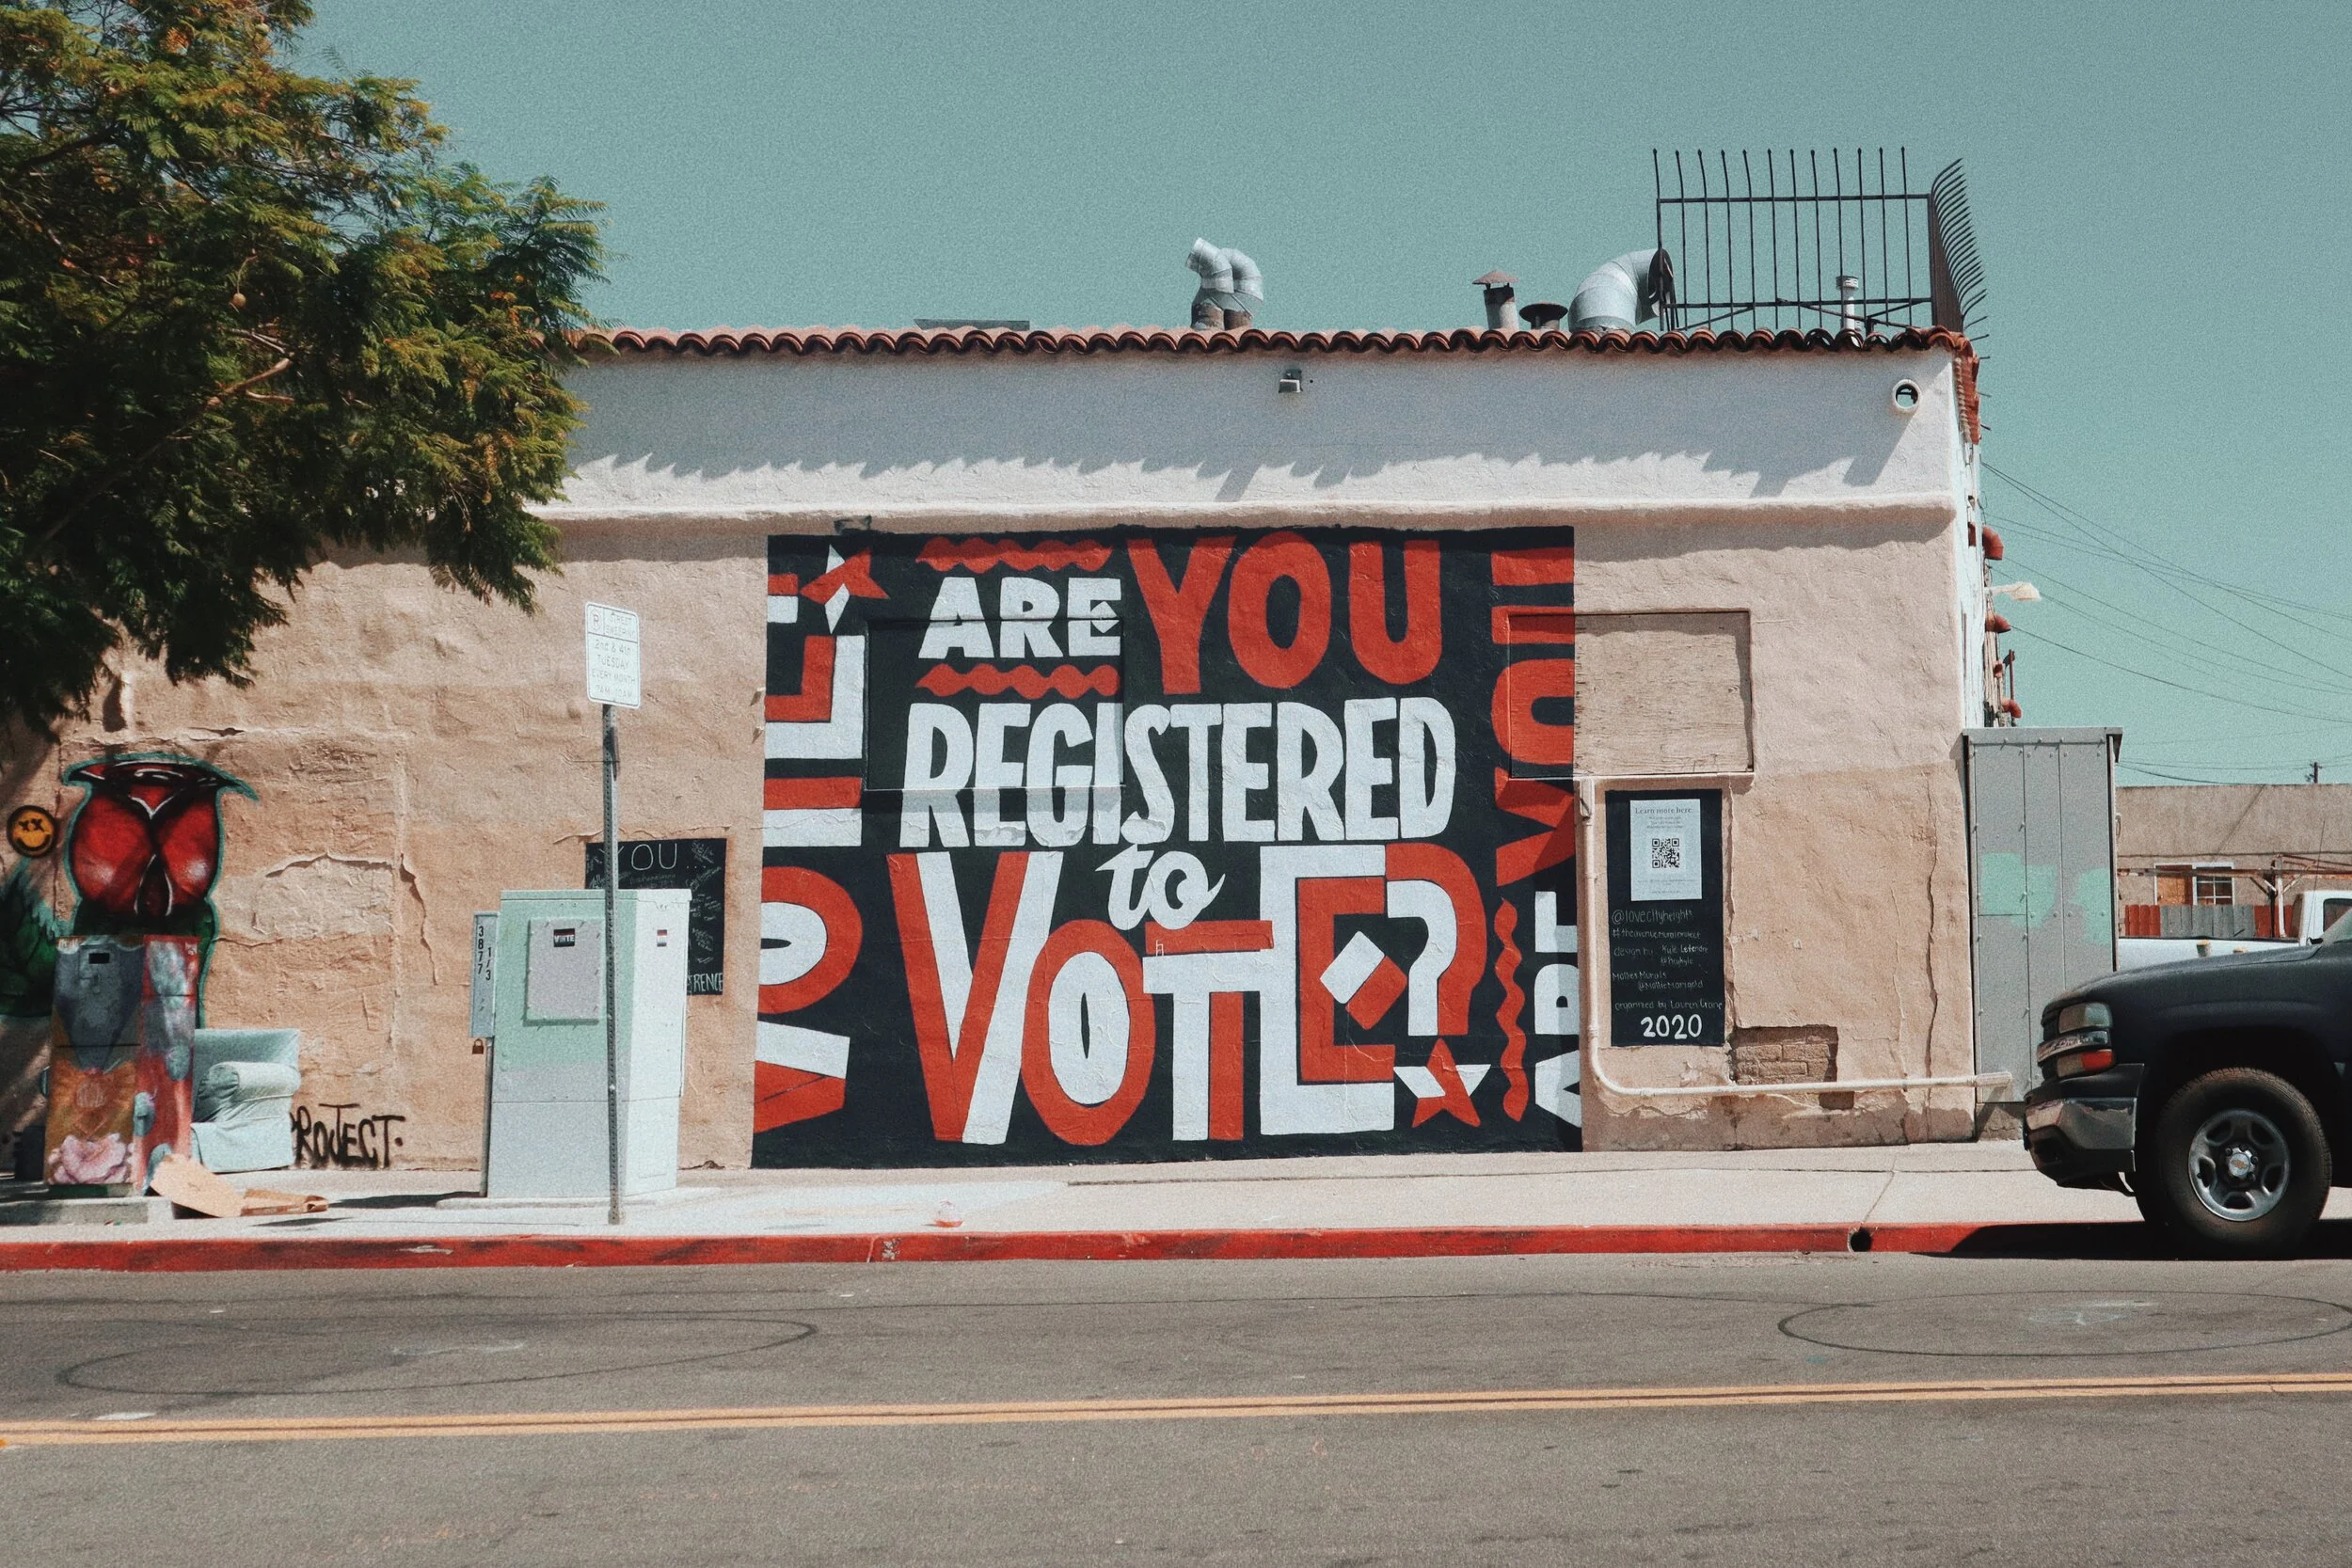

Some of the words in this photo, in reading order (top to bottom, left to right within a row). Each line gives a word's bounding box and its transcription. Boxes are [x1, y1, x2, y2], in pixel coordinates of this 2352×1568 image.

[917, 576, 1122, 659] ARE
[1128, 531, 1443, 695] YOU
[592, 668, 612, 680] EVERY
[614, 673, 636, 686] MONTH
[597, 654, 630, 670] TUESDAY
[898, 696, 1457, 847] REGISTERED
[1095, 842, 1227, 931] to
[1613, 946, 1642, 958] design
[1661, 943, 1677, 955] Kyle
[887, 842, 1488, 1145] VOTE?
[1658, 1000, 1667, 1010] by
[1640, 1013, 1703, 1039] 2020
[290, 1102, 406, 1169] ROJECT.
